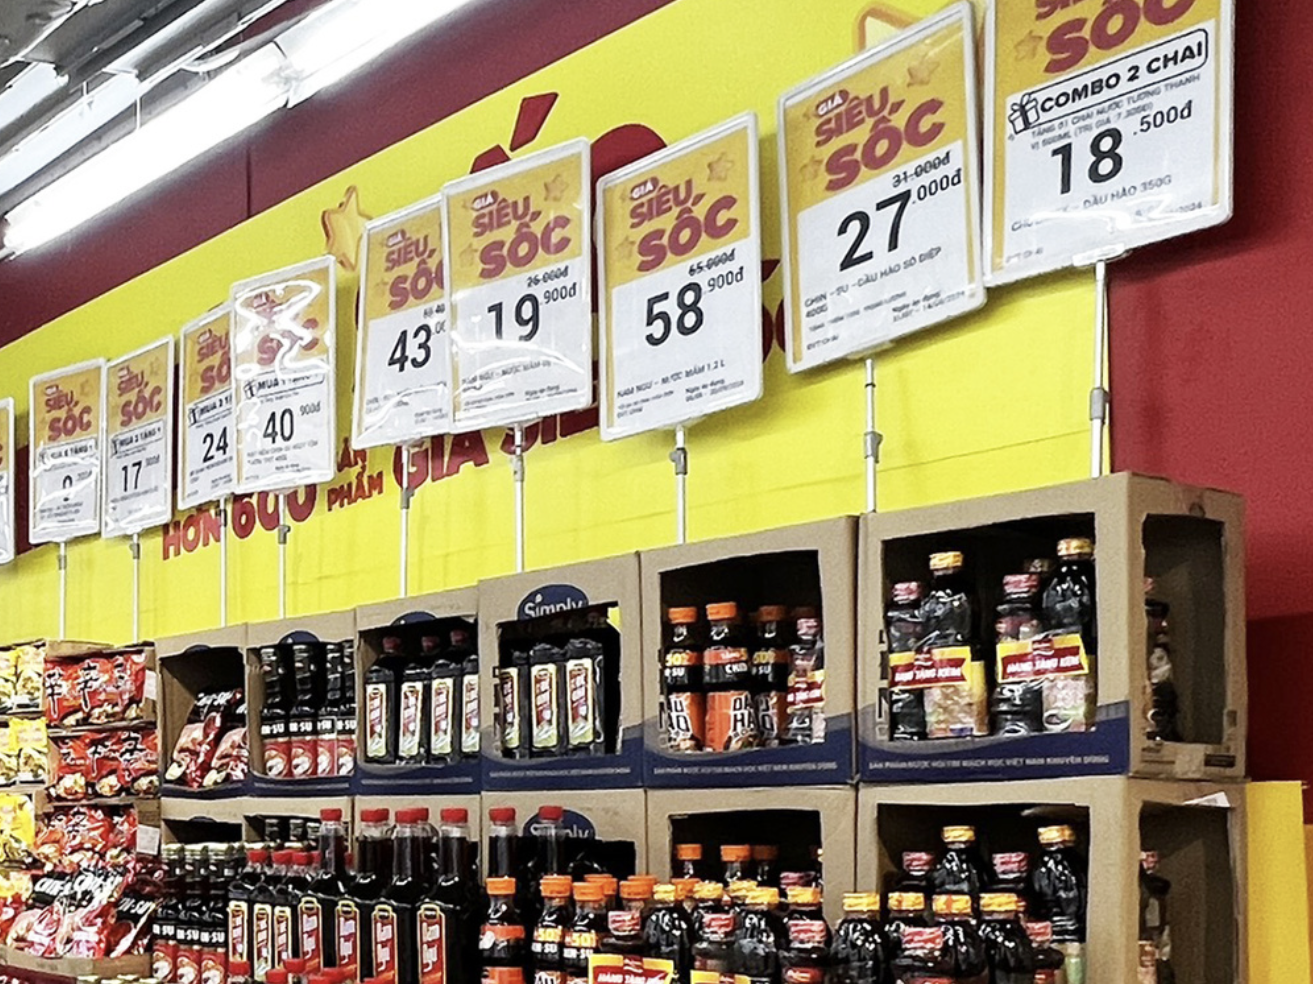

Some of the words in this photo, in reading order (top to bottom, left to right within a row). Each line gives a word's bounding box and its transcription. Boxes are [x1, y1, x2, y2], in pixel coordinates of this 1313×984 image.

[1040, 72, 1122, 113] COMBO
[1127, 65, 1140, 82] 2
[1146, 41, 1203, 74] CHAI
[815, 86, 890, 148] SIÊU
[824, 98, 945, 192] SỐC
[1051, 127, 1123, 195] 18
[472, 195, 531, 238] SIÊU
[630, 178, 693, 229] SIÊU
[385, 235, 429, 272] SIÊU
[479, 209, 572, 280] SỐC
[636, 193, 739, 272] SỐC
[387, 323, 432, 372] 43
[48, 401, 92, 441] SỐC
[120, 381, 162, 427] SỐC
[263, 408, 294, 444] 40
[202, 426, 229, 463] 24
